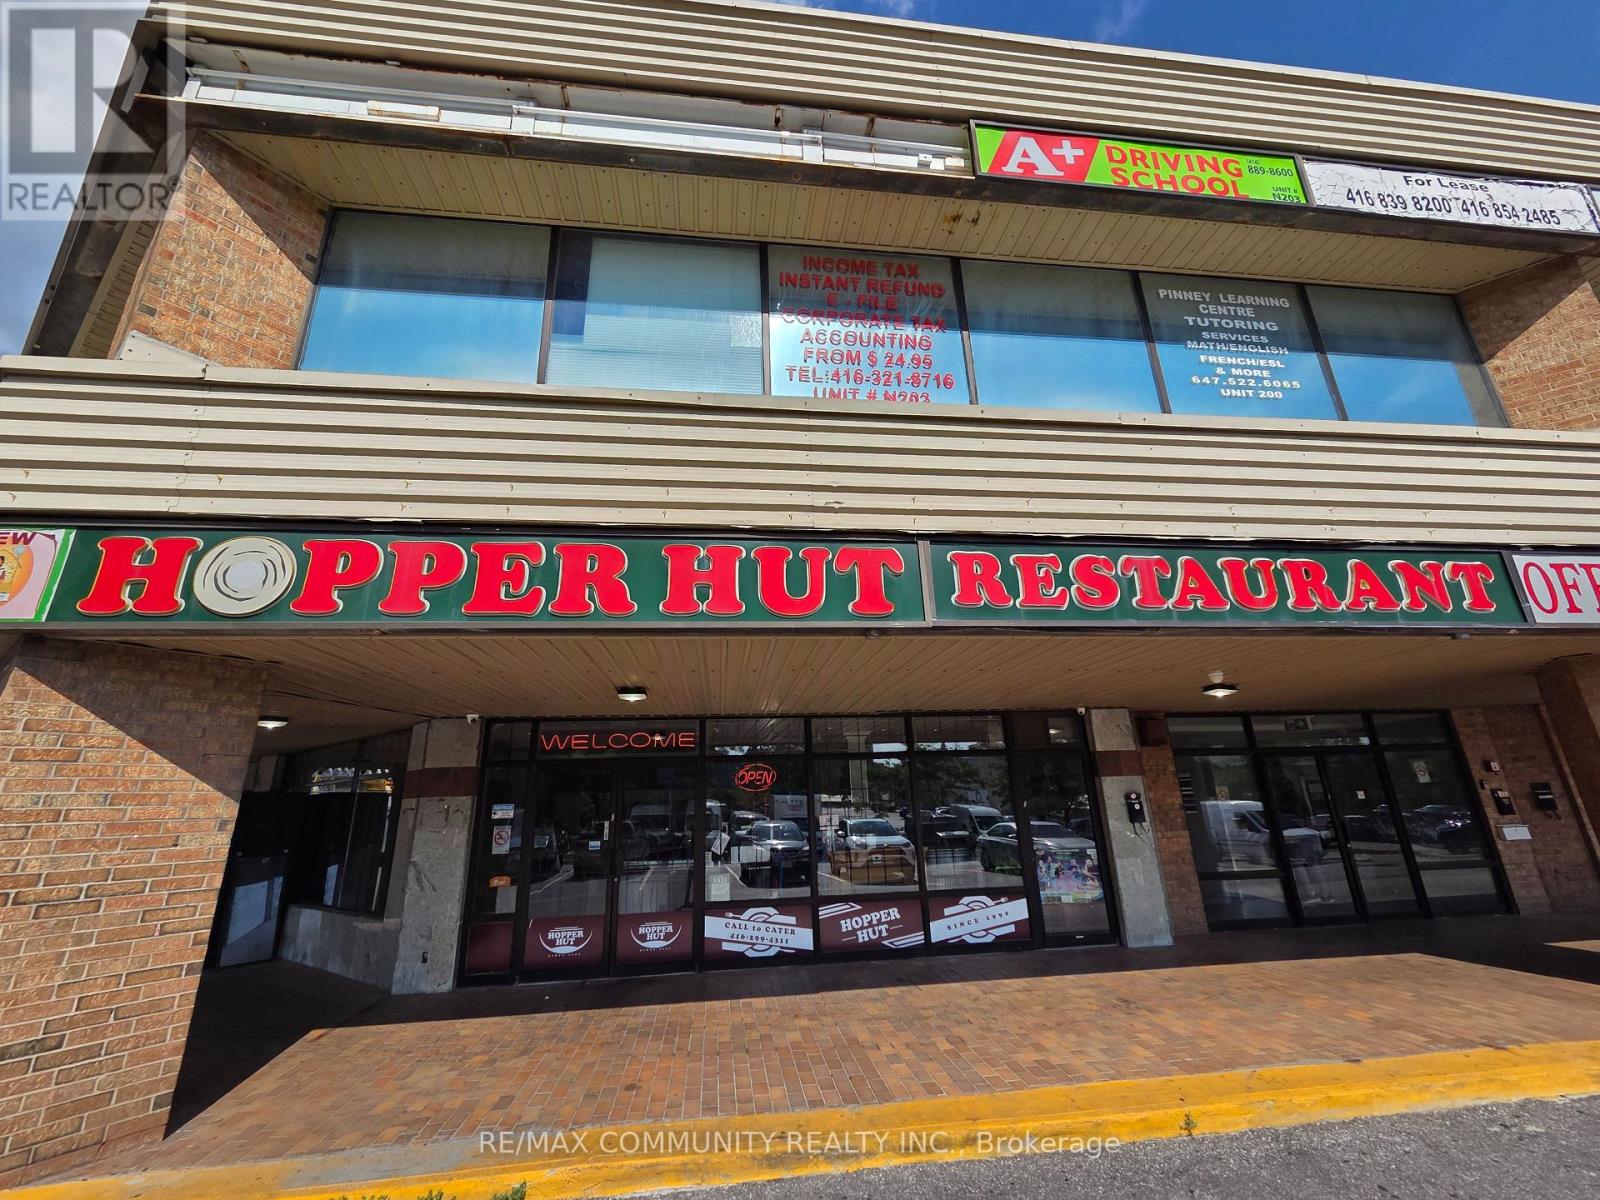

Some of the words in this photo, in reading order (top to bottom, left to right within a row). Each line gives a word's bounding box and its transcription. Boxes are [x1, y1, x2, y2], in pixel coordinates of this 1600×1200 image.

[1001, 136, 1085, 177] A+
[1105, 144, 1243, 179] DRIVING
[1247, 165, 1294, 177] 889-8600
[1110, 167, 1250, 199] SCHOOL
[1403, 175, 1433, 188] For
[1439, 177, 1490, 194] Lease
[1272, 193, 1302, 203] N203
[1346, 187, 1374, 206] 416
[1377, 193, 1408, 210] 839
[1411, 196, 1450, 214] 8200
[1460, 199, 1490, 218] 416
[1493, 202, 1521, 222] 854
[1525, 207, 1562, 226] 2485
[803, 255, 880, 276] INCOME
[883, 262, 921, 279] TAX
[779, 271, 861, 292] INSTANT
[866, 278, 946, 299] REFUND
[856, 293, 899, 310] FILE
[1158, 288, 1211, 302] PINNEY
[1219, 293, 1291, 308] LEARNING
[1198, 303, 1256, 318] CENTRE
[781, 307, 906, 331] CORPORATE
[910, 315, 949, 333] TAX
[1183, 316, 1280, 332] TUTORING
[799, 328, 933, 351] ACCOUNTING
[1201, 331, 1270, 343] SERVICES
[803, 348, 863, 367] FROM
[867, 350, 879, 367] $
[884, 352, 934, 371] 24.95
[1216, 366, 1227, 376] &
[1230, 367, 1273, 379] MORE
[1191, 375, 1302, 390] 647.522.6065
[812, 386, 861, 400] UNIT
[865, 389, 879, 401] #
[882, 391, 932, 404] N203
[1220, 387, 1255, 399] UNIT
[1258, 388, 1284, 400] 200
[659, 543, 905, 618] HUT
[944, 548, 1498, 616] RESTAURANT
[539, 732, 696, 750] WELCOME
[737, 769, 775, 785] OPEN
[840, 907, 901, 932] HOPPER
[946, 917, 979, 931] SINCE
[548, 930, 584, 940] HOPPER
[638, 925, 673, 935] HOPPER
[646, 933, 666, 941] HUT
[724, 922, 748, 931] CALL
[765, 926, 796, 936] CATER
[857, 924, 890, 943] HUT
[555, 938, 576, 946] HUT
